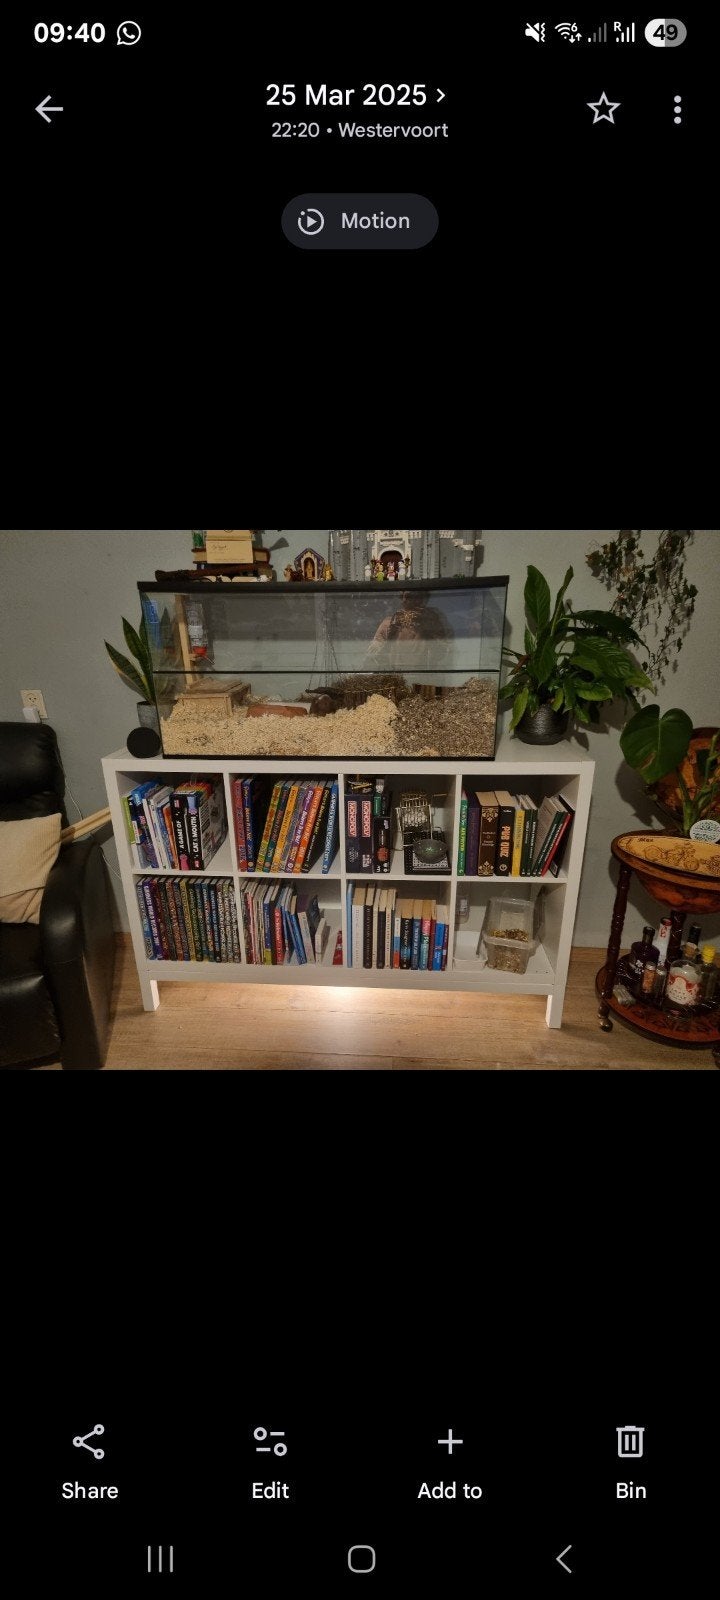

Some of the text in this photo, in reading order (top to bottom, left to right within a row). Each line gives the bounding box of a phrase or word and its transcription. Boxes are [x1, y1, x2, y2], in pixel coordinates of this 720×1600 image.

[190, 816, 198, 838] MOUTH
[500, 825, 510, 857] PUB QUIZ
